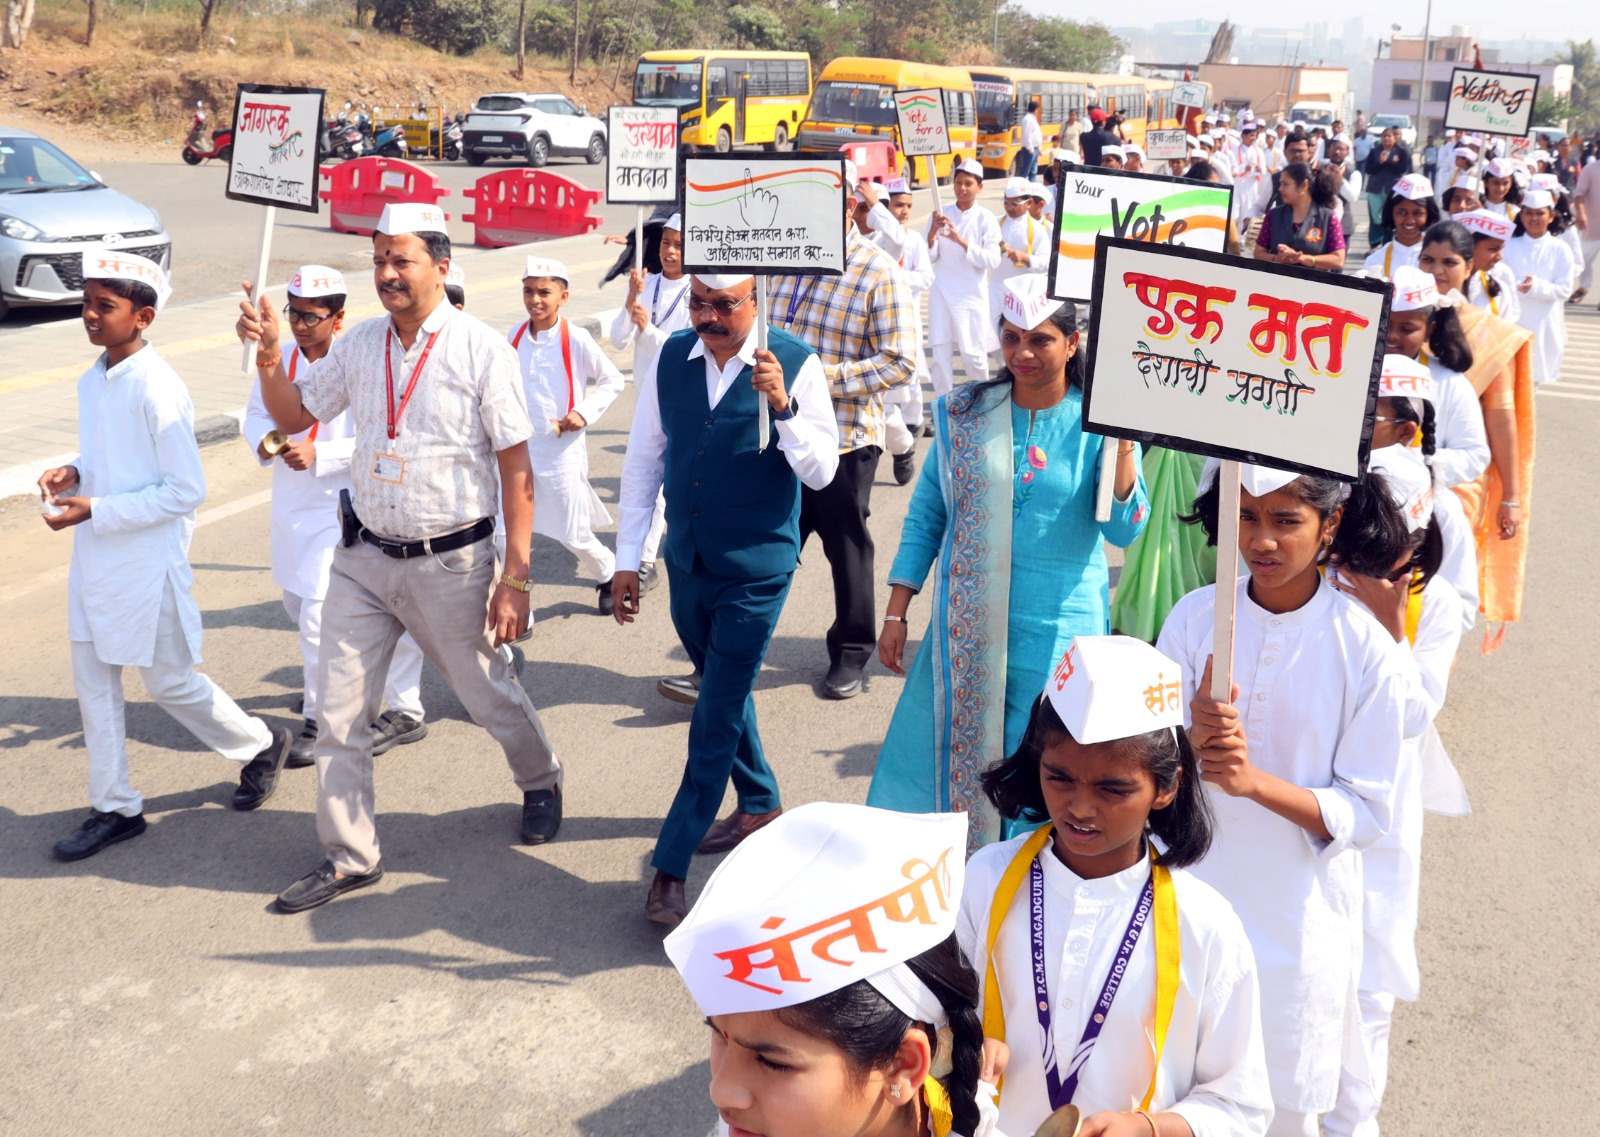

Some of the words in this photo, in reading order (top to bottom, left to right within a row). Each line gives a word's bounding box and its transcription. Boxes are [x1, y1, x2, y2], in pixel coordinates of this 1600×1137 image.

[1459, 75, 1529, 115] Voting
[906, 109, 928, 124] Vote
[915, 124, 934, 136] for
[623, 121, 677, 150] उत्थान
[617, 166, 672, 190] मतदान
[1074, 179, 1104, 199] Your
[688, 225, 723, 245] निर्भय
[750, 227, 782, 242] मतदान
[1110, 197, 1189, 247] Vote
[705, 243, 764, 264] अधिकाराचा
[1123, 271, 1237, 345] एक
[1247, 293, 1370, 377] मत
[1132, 340, 1220, 396] देशाची
[1225, 367, 1316, 416] प्रगती
[1031, 871, 1045, 947] JAGADGURU
[1132, 881, 1154, 925] SCHOOL
[1121, 940, 1135, 956] Jr.
[1032, 948, 1047, 995] P.C.M.C.
[1099, 958, 1128, 1010] COLLEGE
